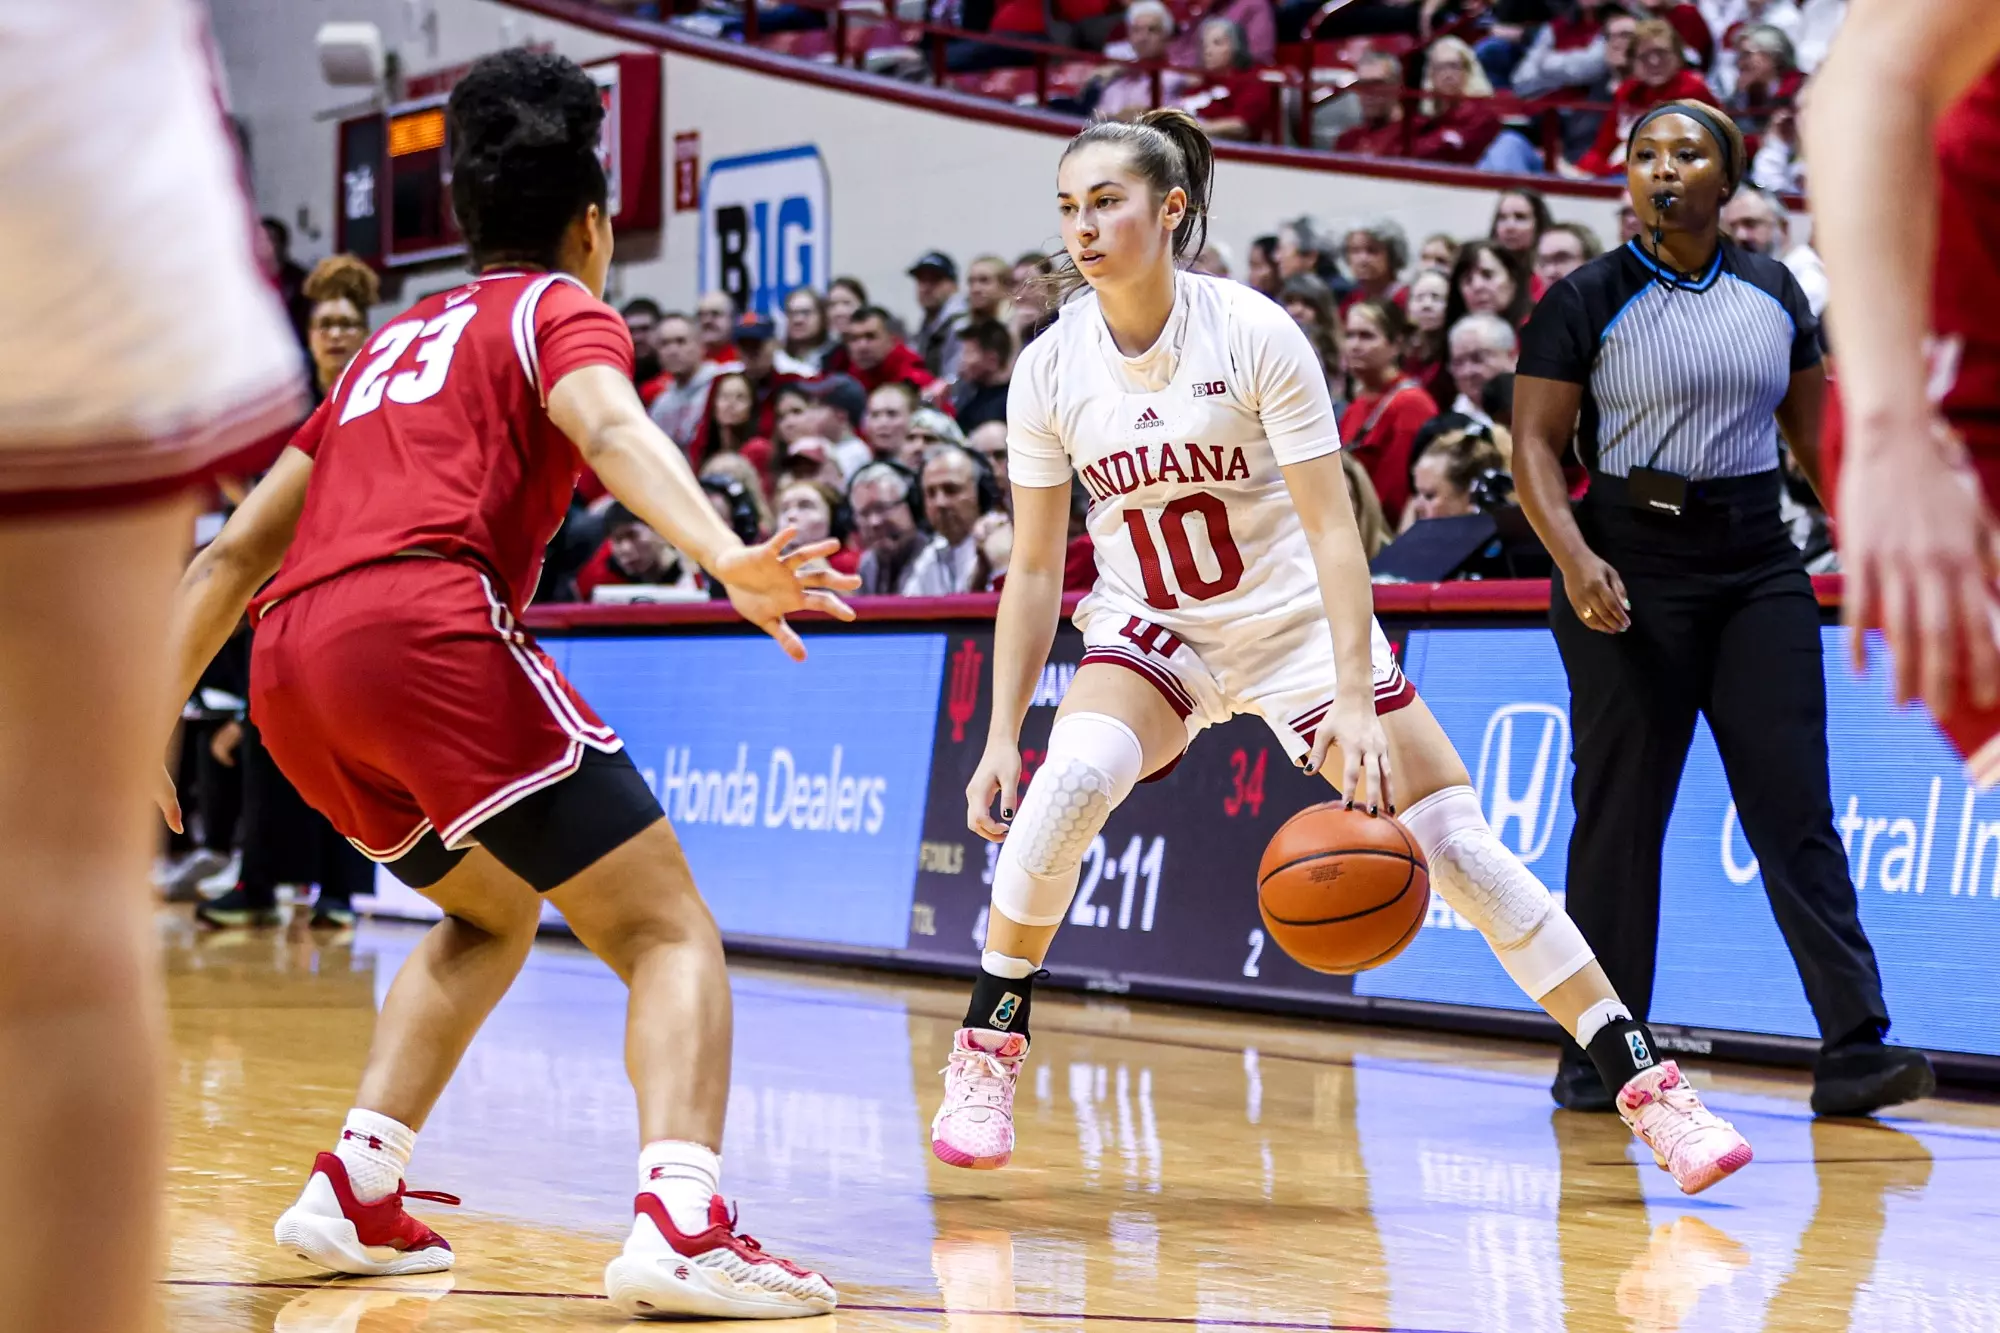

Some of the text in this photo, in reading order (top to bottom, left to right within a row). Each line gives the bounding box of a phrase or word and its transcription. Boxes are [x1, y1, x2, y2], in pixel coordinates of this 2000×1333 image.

[338, 303, 478, 427] 23
[1133, 418, 1165, 430] adidas
[1081, 442, 1250, 501] INDIANA
[1122, 491, 1245, 610] 10
[664, 741, 887, 836] Honda Dealers
[1223, 747, 1269, 817] 34
[1720, 775, 1942, 895] Ctral
[1243, 928, 1264, 978] 2
